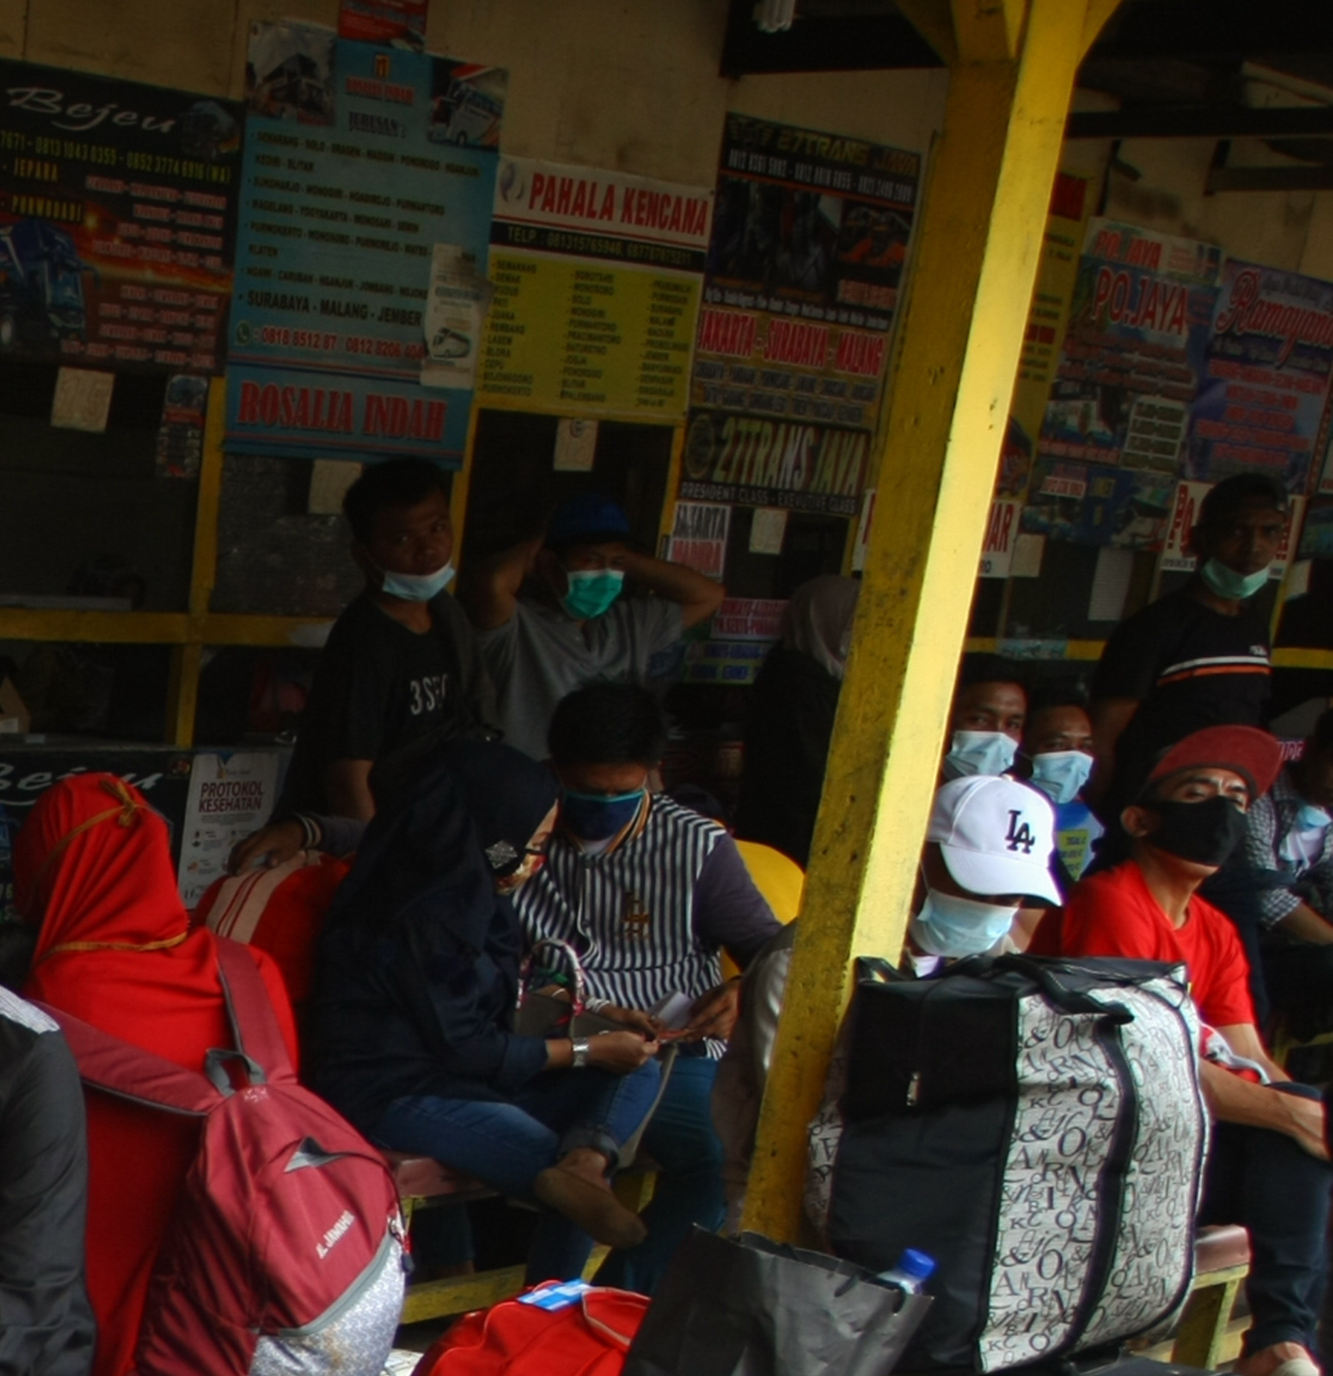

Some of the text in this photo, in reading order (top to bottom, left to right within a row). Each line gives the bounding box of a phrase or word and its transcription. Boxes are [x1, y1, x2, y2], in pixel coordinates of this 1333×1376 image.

[6, 86, 176, 134] Bejeu
[13, 156, 59, 183] JEPARA
[529, 173, 708, 236] PAHALA KENCANA
[247, 290, 422, 327] SURABAYA MALANG JEMBER
[238, 381, 447, 443] ROSALIA INDAH
[681, 481, 736, 502] PRESIDENT
[738, 486, 768, 506] CLASS
[199, 798, 262, 812] KESEHATAN
[201, 781, 263, 797] PROTOKOL
[1007, 810, 1035, 853] LA
